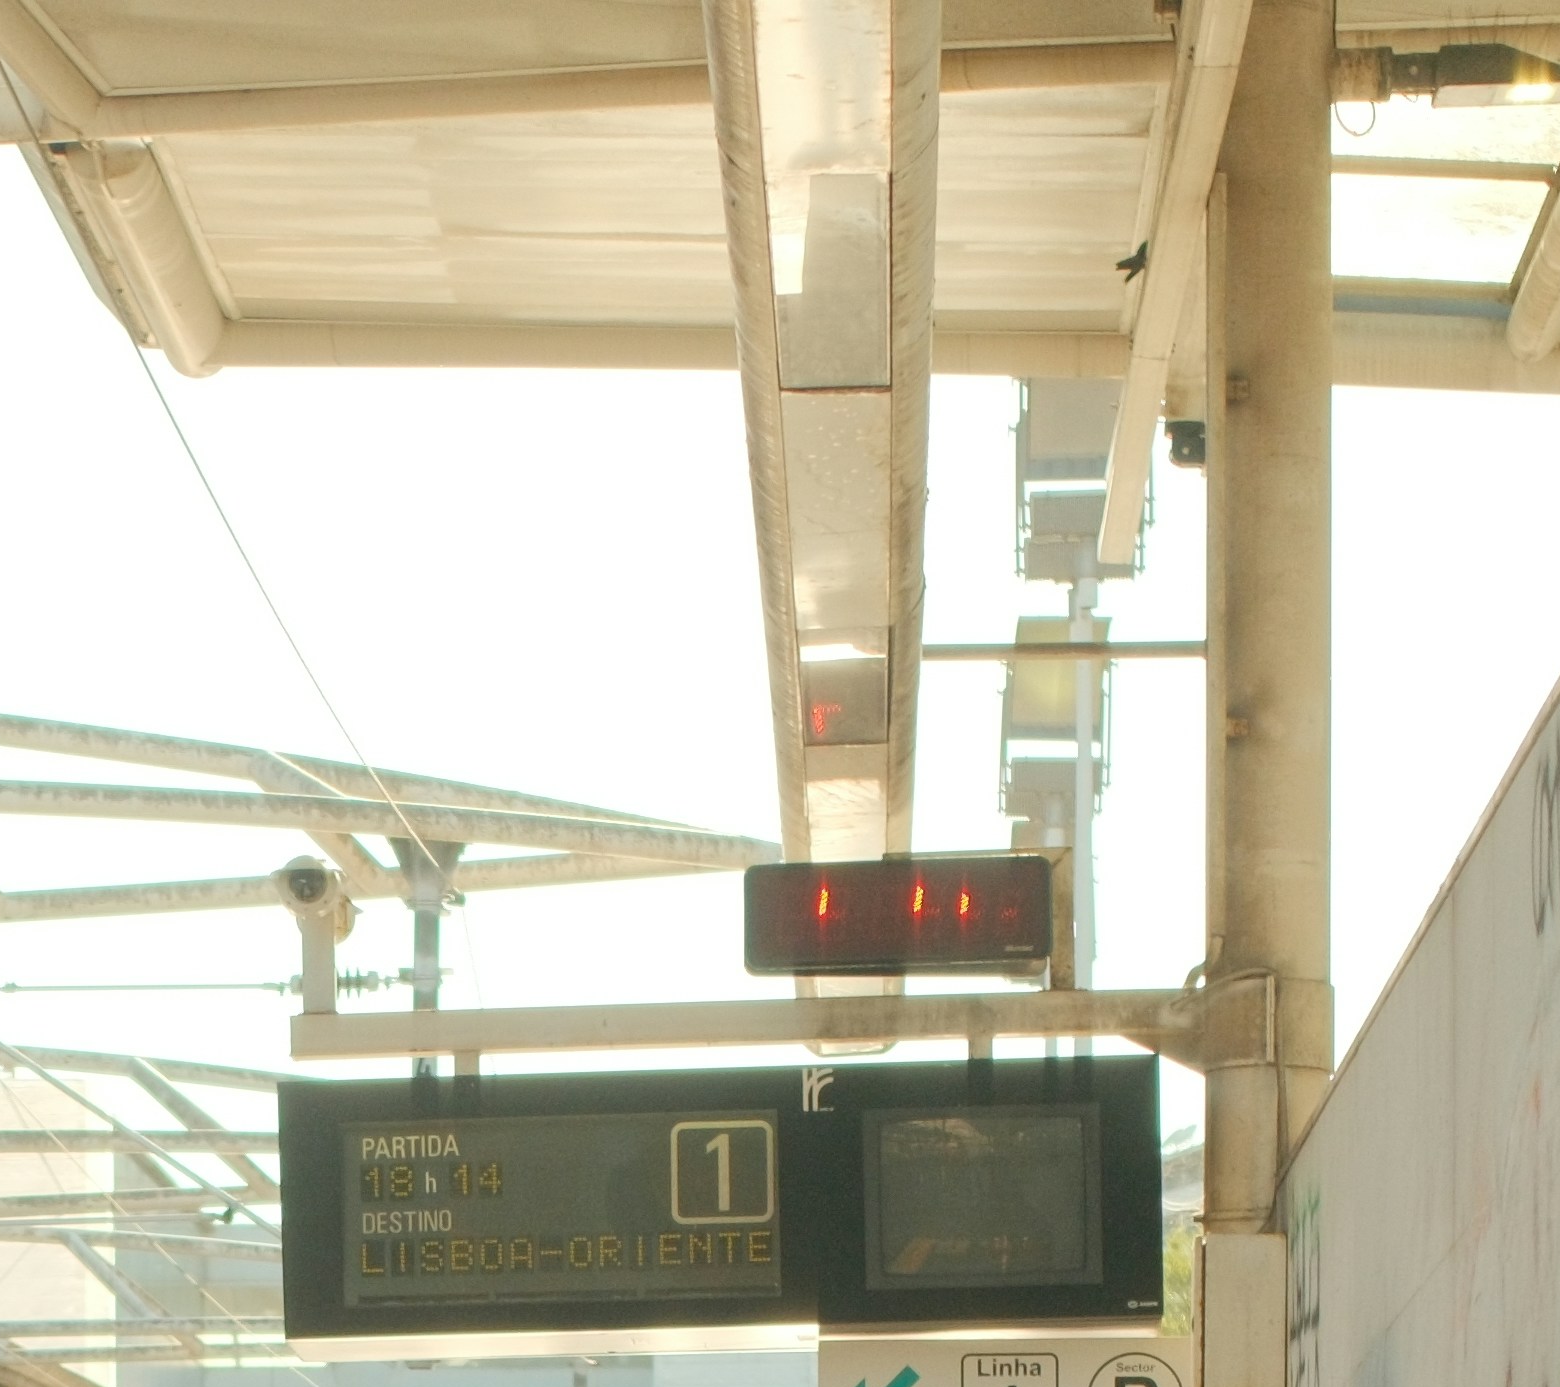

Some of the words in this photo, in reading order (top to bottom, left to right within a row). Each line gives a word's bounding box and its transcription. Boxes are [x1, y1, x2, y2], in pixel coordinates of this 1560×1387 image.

[361, 1134, 460, 1161] PARTIDA
[424, 1171, 438, 1194] h
[453, 1162, 503, 1196] 14
[705, 1132, 731, 1213] 1
[361, 1210, 453, 1235] DESTINO
[361, 1231, 772, 1274] LISBOA-ORIENTE
[976, 1358, 1042, 1378] Linha
[1115, 1361, 1156, 1374] Sector
